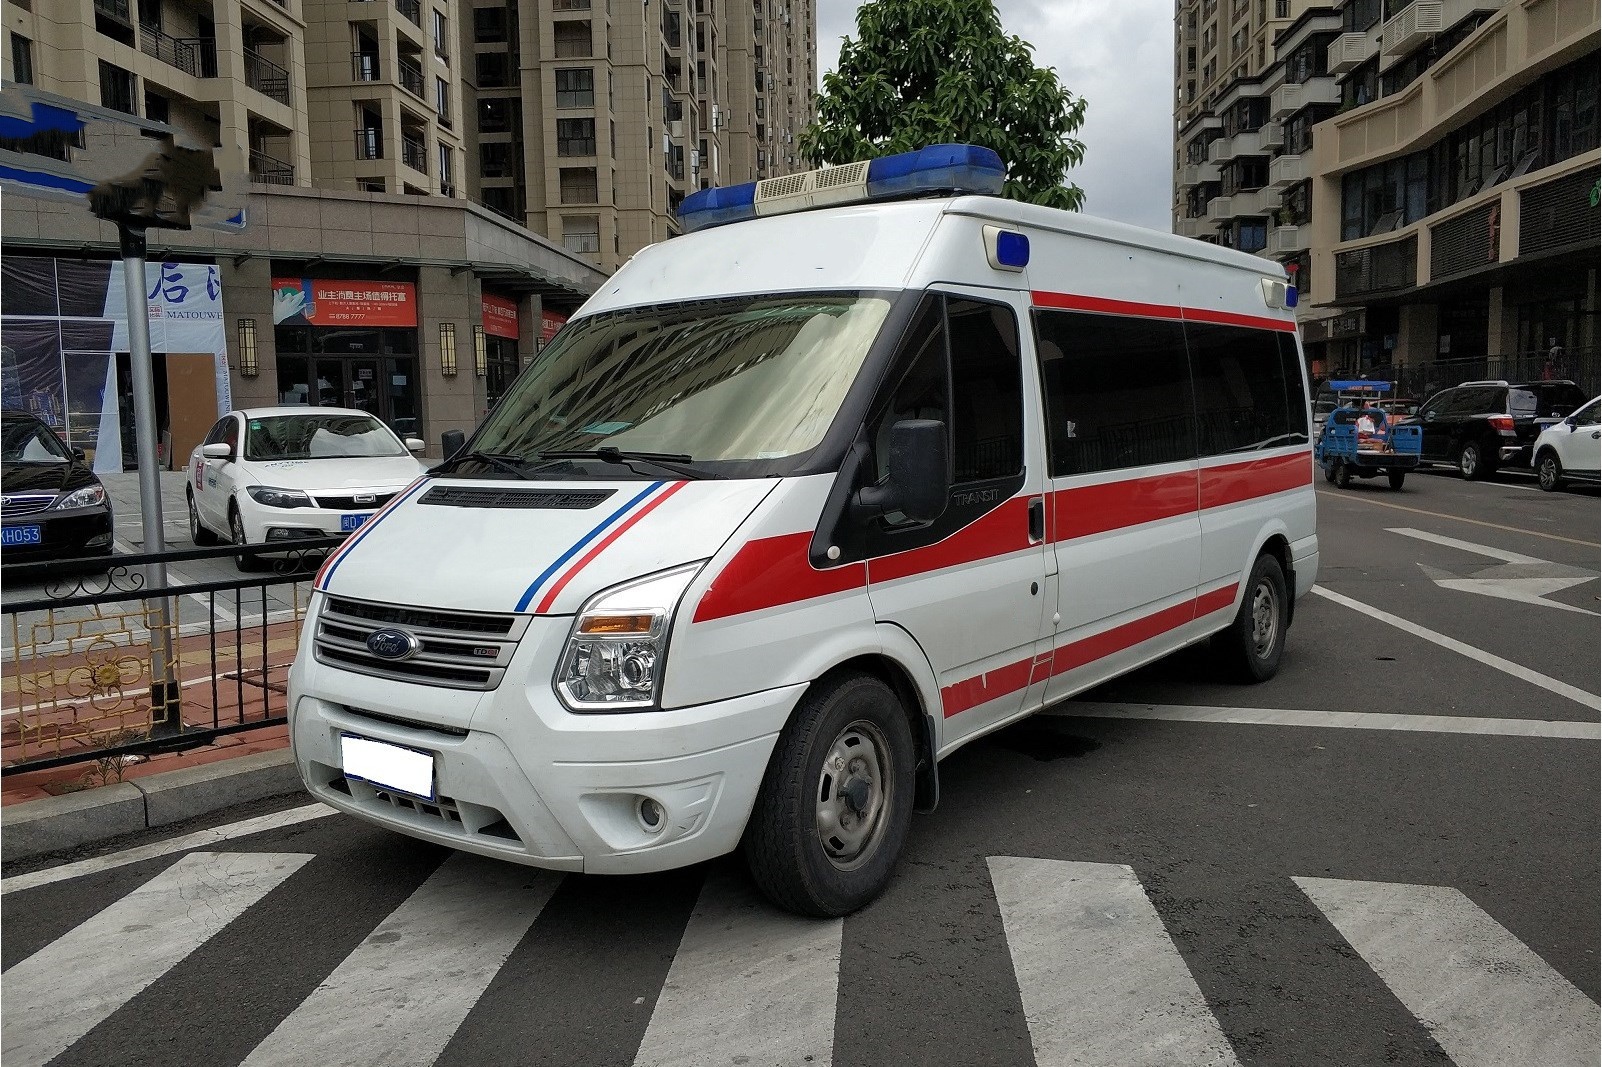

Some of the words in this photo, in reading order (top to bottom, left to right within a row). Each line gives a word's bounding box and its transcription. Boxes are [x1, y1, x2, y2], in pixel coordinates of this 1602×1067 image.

[167, 311, 223, 320] MATOUWE
[954, 489, 999, 506] TRANSIT
[373, 633, 401, 653] Ford
